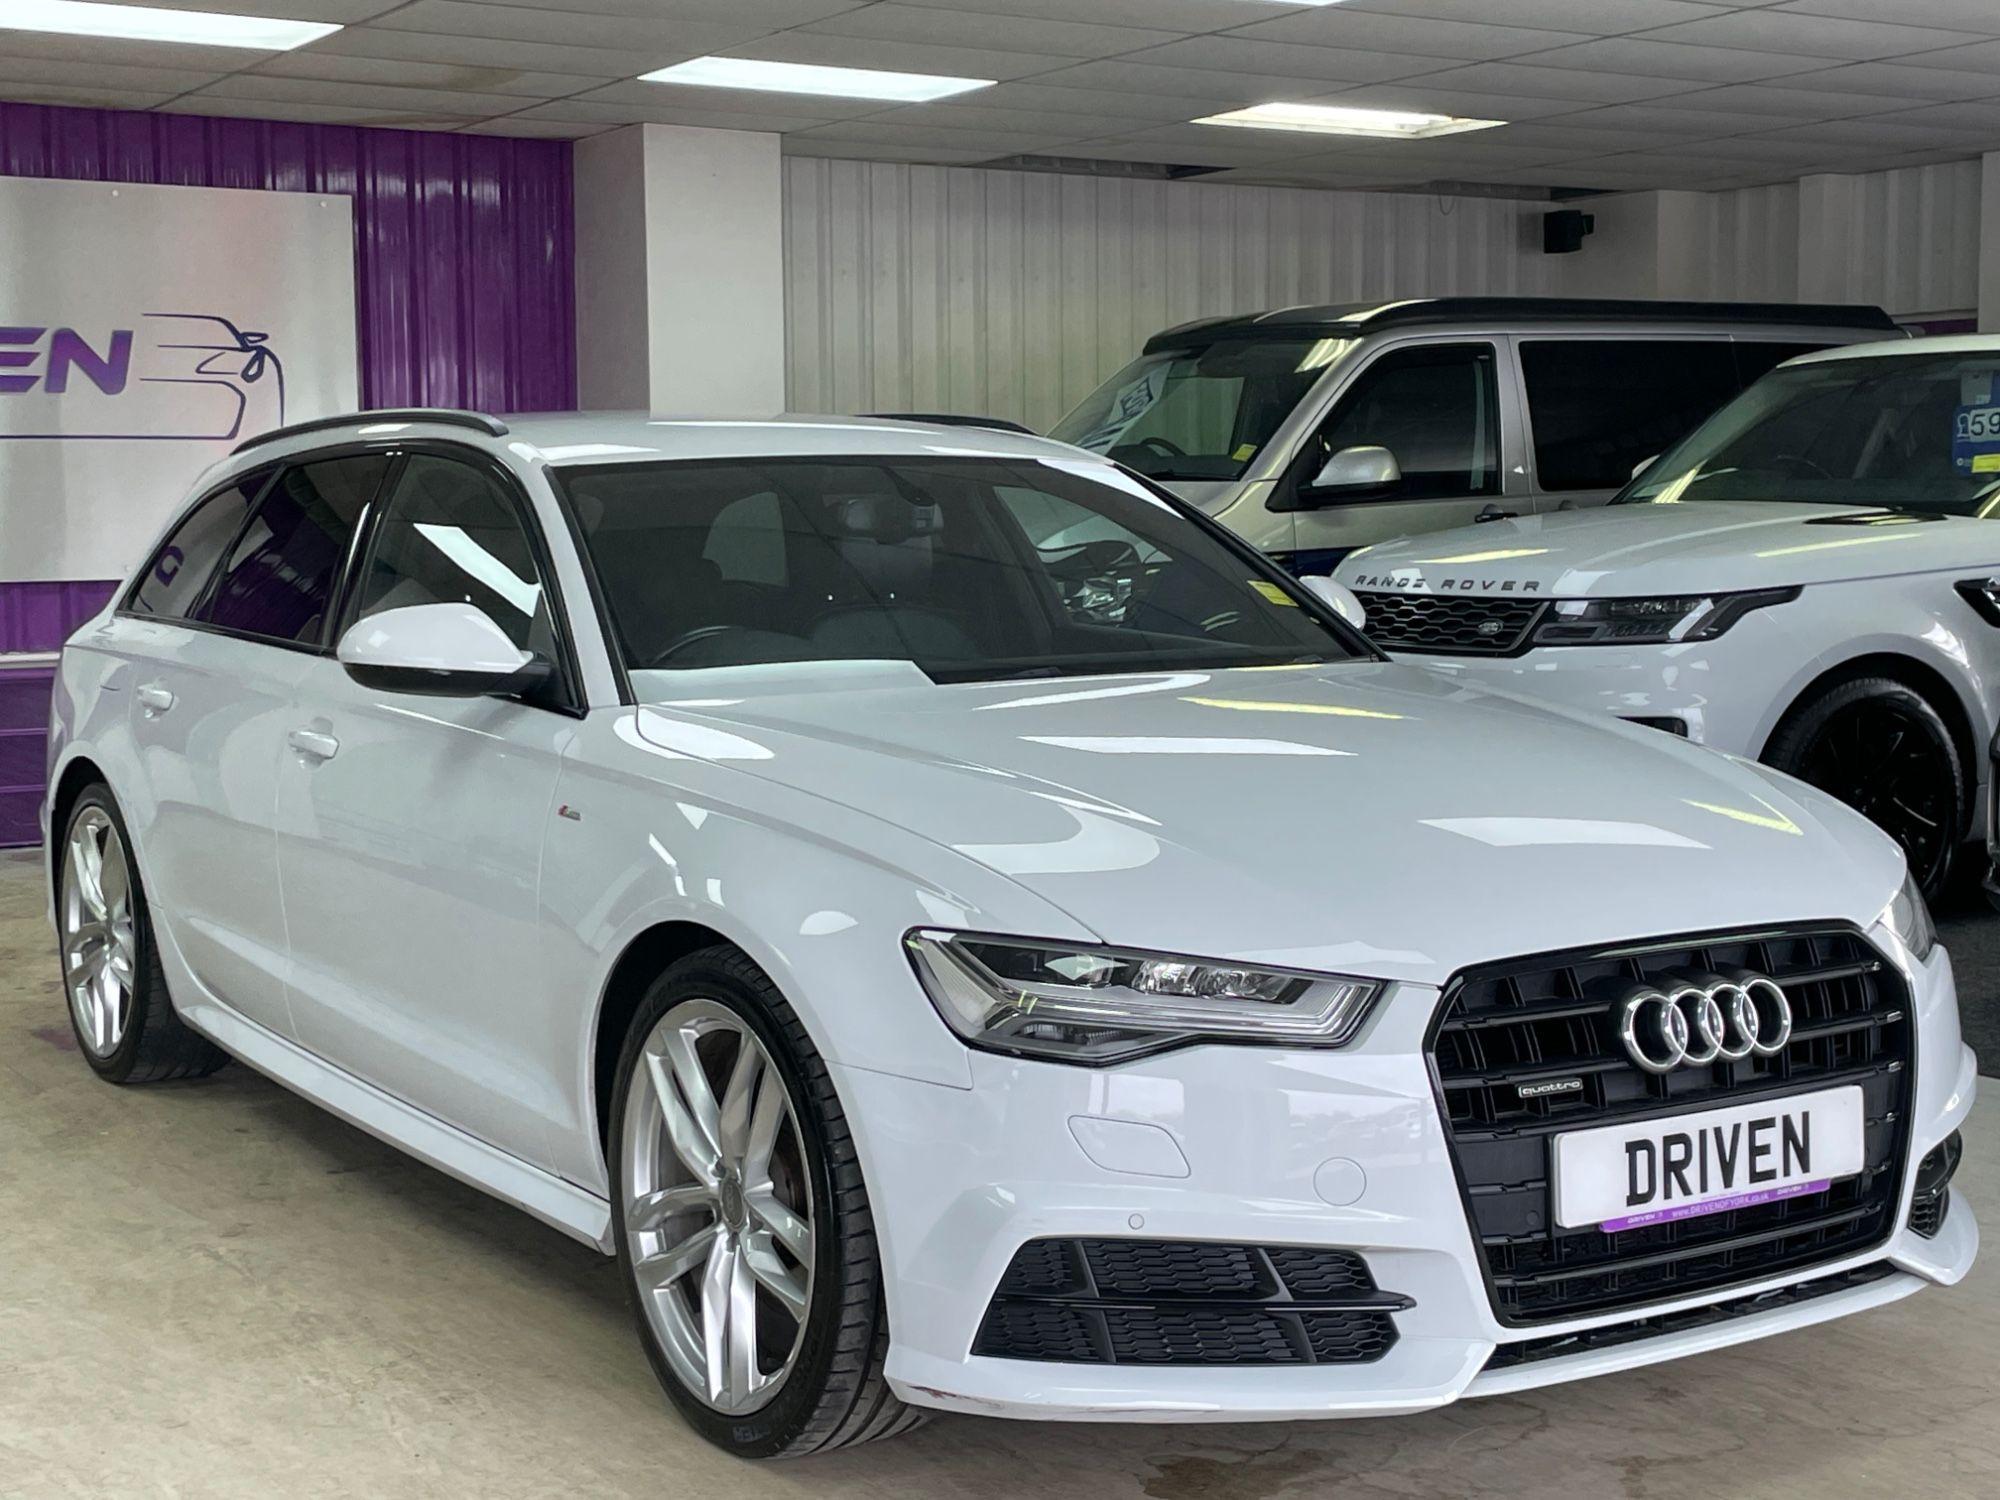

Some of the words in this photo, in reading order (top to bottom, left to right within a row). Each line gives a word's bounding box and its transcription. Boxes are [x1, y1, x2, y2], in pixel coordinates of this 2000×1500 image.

[1355, 575, 1427, 588] RANGE
[1441, 579, 1541, 592] ROVER
[1521, 1081, 1581, 1097] quattro
[1625, 1110, 1811, 1207] DRIVEN
[1627, 1213, 1656, 1225] DRIVEN
